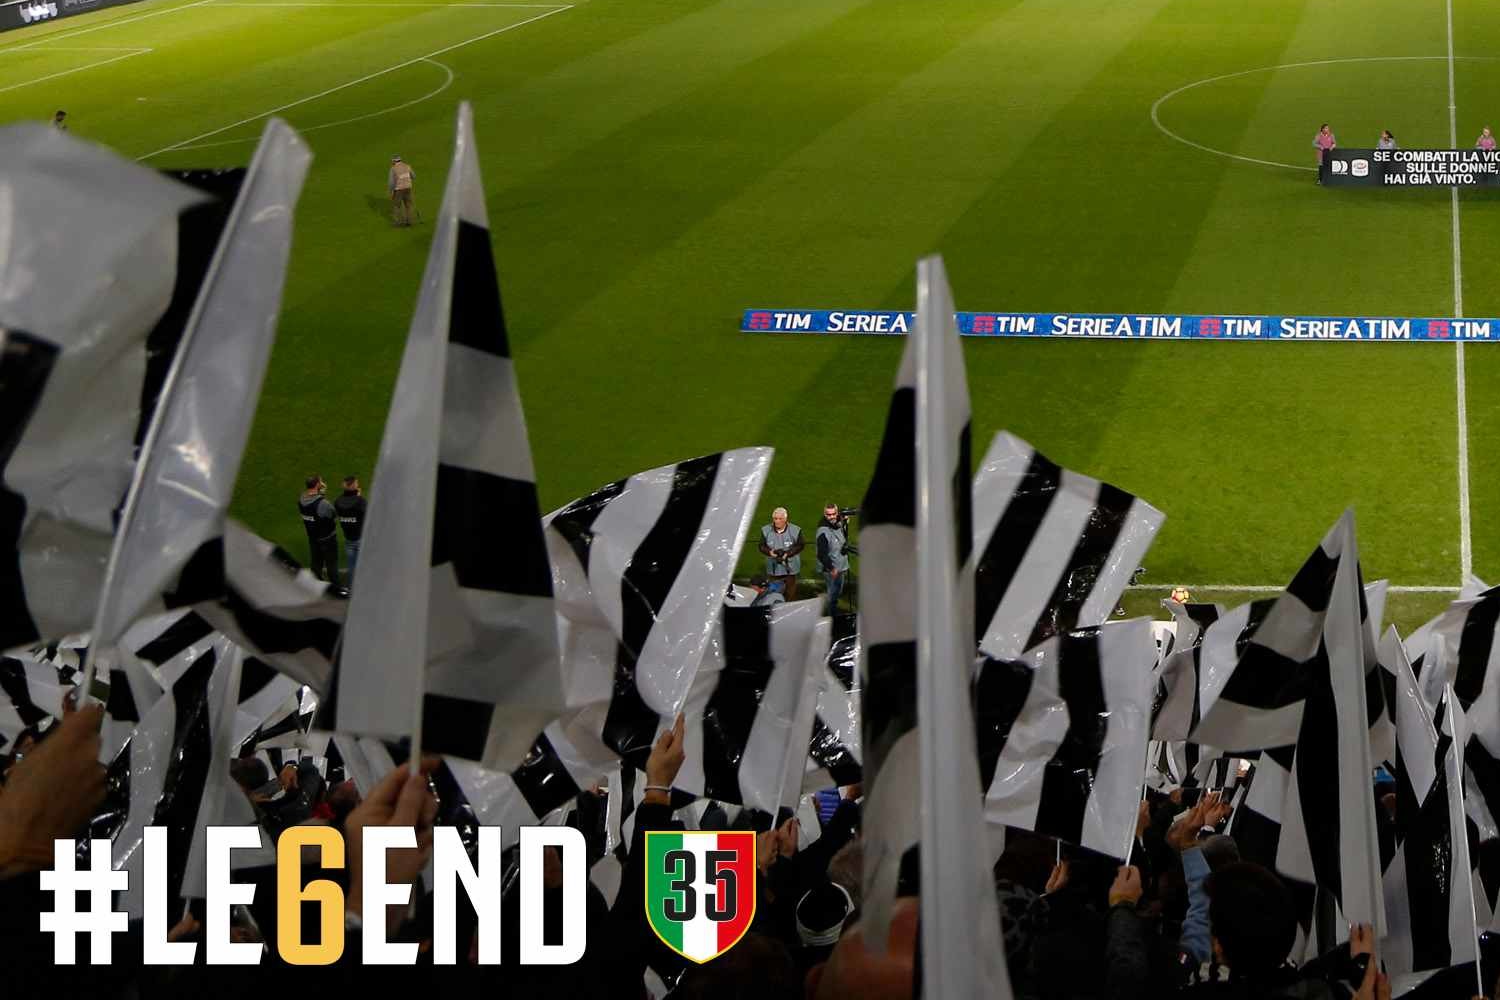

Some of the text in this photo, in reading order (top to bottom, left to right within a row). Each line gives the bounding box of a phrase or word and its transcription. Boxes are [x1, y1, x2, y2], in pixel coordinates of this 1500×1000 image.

[1373, 151, 1390, 162] SE
[1393, 151, 1459, 162] COMBATTI
[1463, 151, 1479, 162] LA
[1406, 162, 1499, 175] SULLE DONNE,
[1384, 171, 1477, 185] HAI GIÀ VINTO.
[774, 313, 811, 329] TIM
[827, 312, 890, 332] SERIE
[997, 316, 1035, 333] TIM
[1051, 315, 1115, 336] SERIE
[1135, 316, 1182, 337] TIM
[1223, 319, 1262, 336] TIM
[1279, 318, 1343, 339] SERIE
[1364, 319, 1410, 339] TIM
[1451, 321, 1490, 338] TIM
